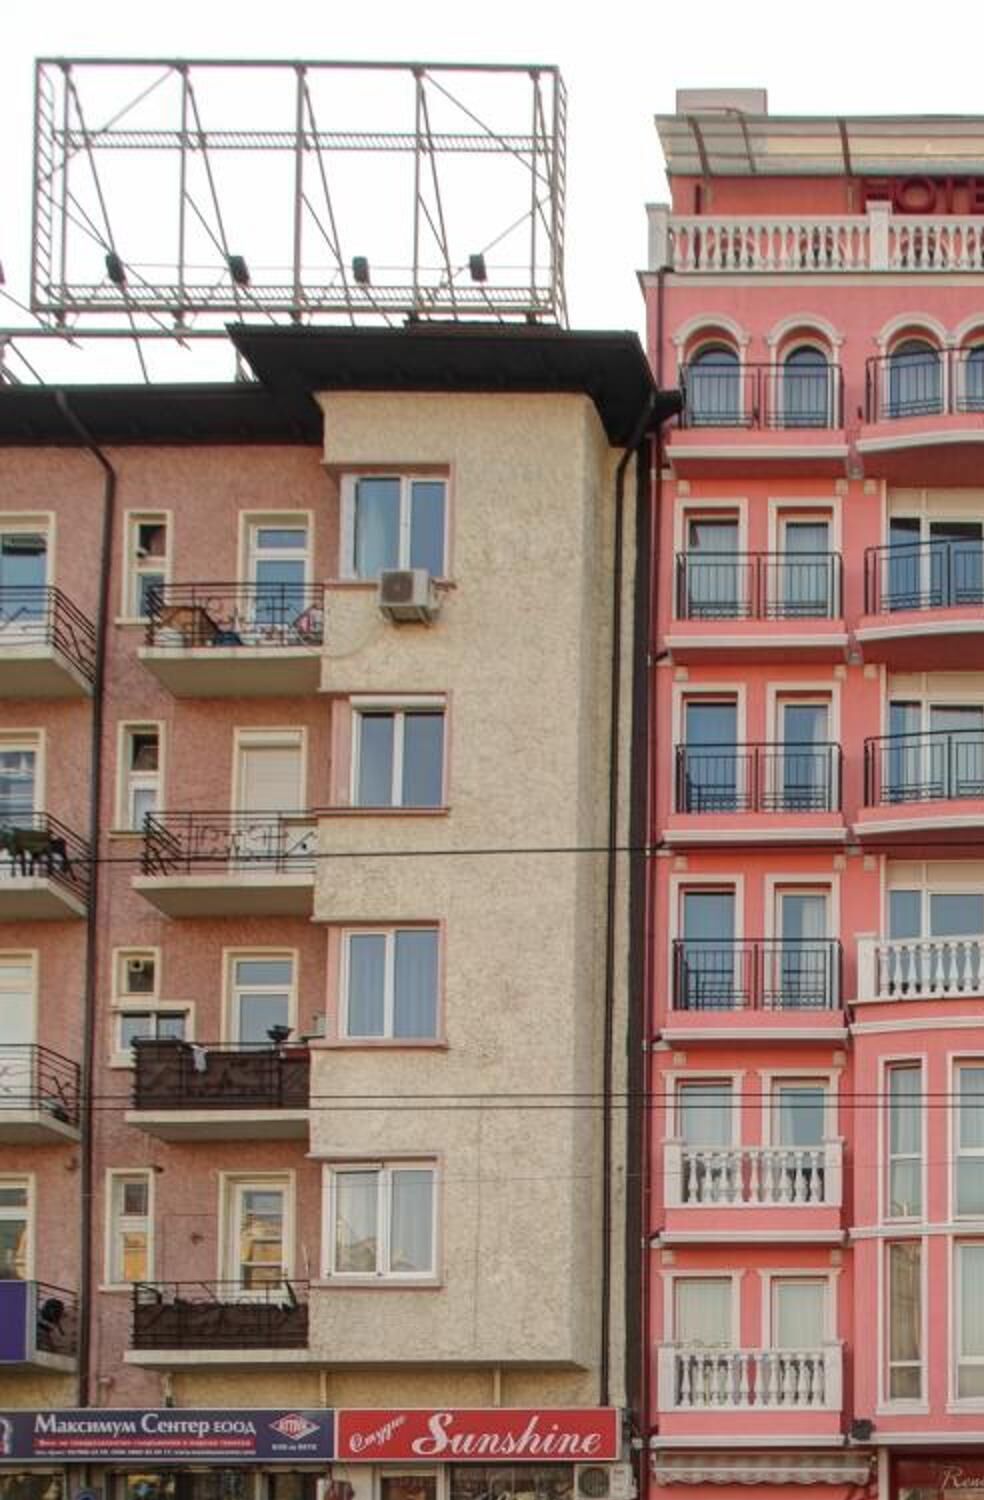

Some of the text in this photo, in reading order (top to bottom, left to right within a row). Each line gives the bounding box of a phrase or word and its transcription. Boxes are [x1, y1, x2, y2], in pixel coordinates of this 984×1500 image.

[34, 1413, 136, 1438] Максимум
[141, 1412, 210, 1438] Сентер
[411, 1413, 601, 1455] Sunshine
